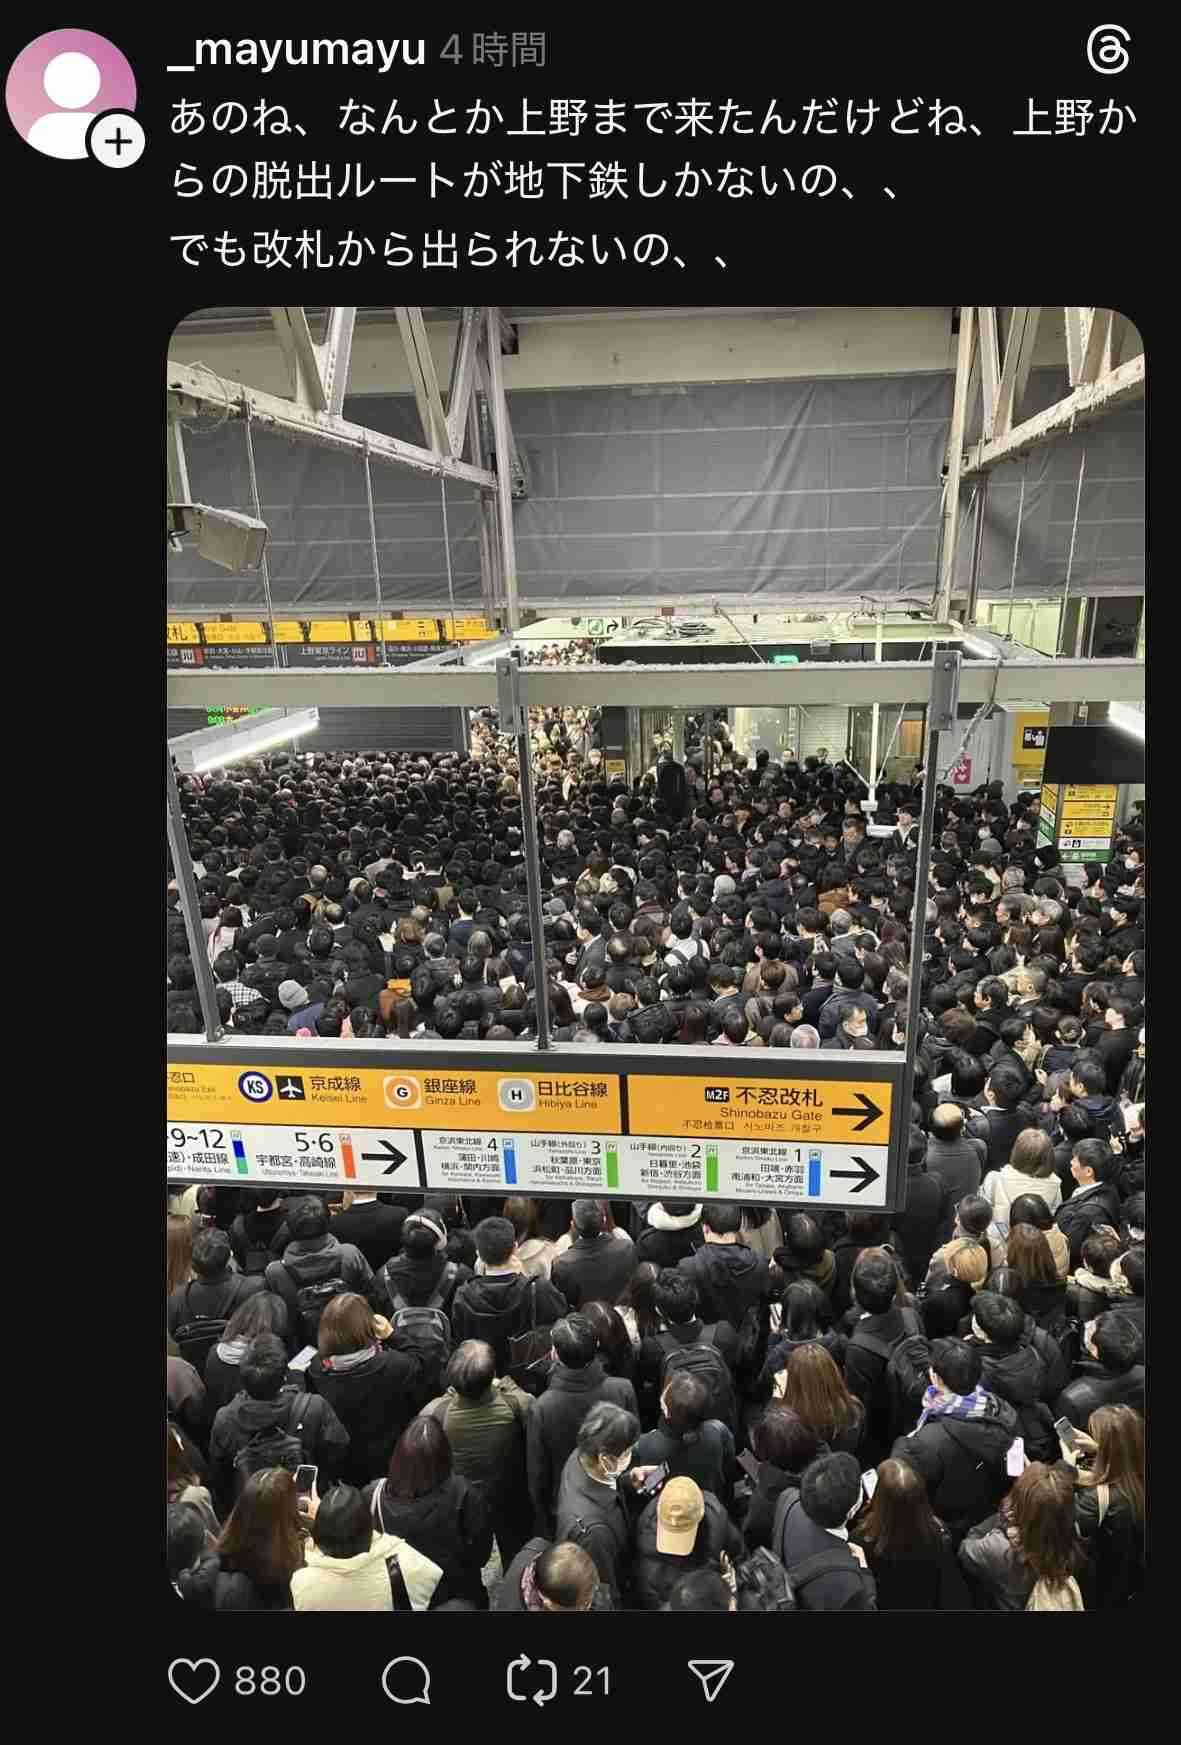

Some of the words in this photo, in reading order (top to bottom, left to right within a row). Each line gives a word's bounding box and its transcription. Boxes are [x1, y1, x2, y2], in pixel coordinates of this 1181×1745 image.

[246, 1079, 264, 1094] KS
[309, 1075, 362, 1092] 京成線
[424, 1077, 478, 1095] 銀座線
[538, 1080, 608, 1097] 日比谷線
[396, 1086, 408, 1098] G
[511, 1089, 523, 1101] H
[705, 1088, 730, 1102] M2F
[735, 1086, 824, 1107] 不忍改札
[425, 1096, 456, 1106] Ginza
[719, 1106, 788, 1120] Shinobazu
[791, 1109, 824, 1121] Gate
[487, 1136, 498, 1152] 4
[591, 1140, 601, 1155] 3
[690, 1143, 702, 1159] 2
[793, 1147, 801, 1162] 1
